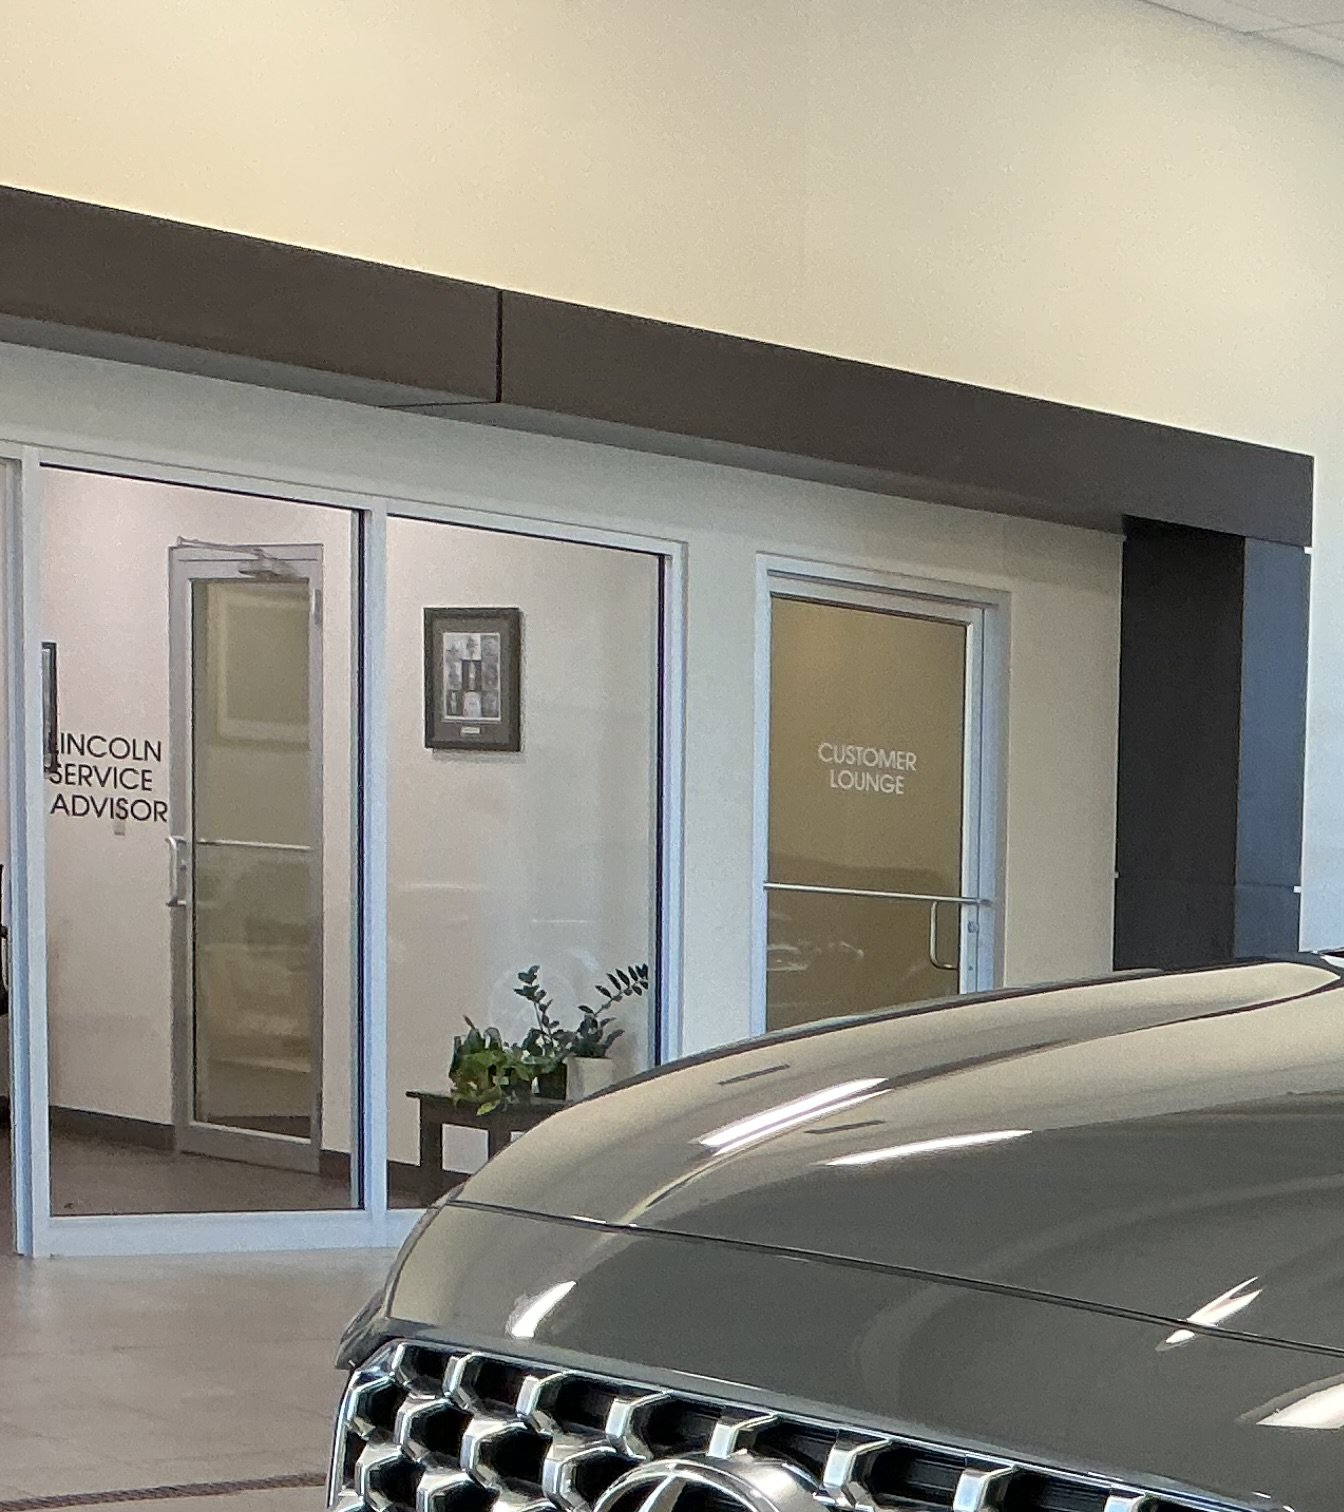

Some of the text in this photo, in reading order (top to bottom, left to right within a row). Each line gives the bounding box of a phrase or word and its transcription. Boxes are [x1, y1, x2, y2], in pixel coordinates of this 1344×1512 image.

[817, 742, 917, 771] CUSTOMER
[830, 769, 904, 794] LOUNGE
[50, 793, 168, 822] ADVISOR
